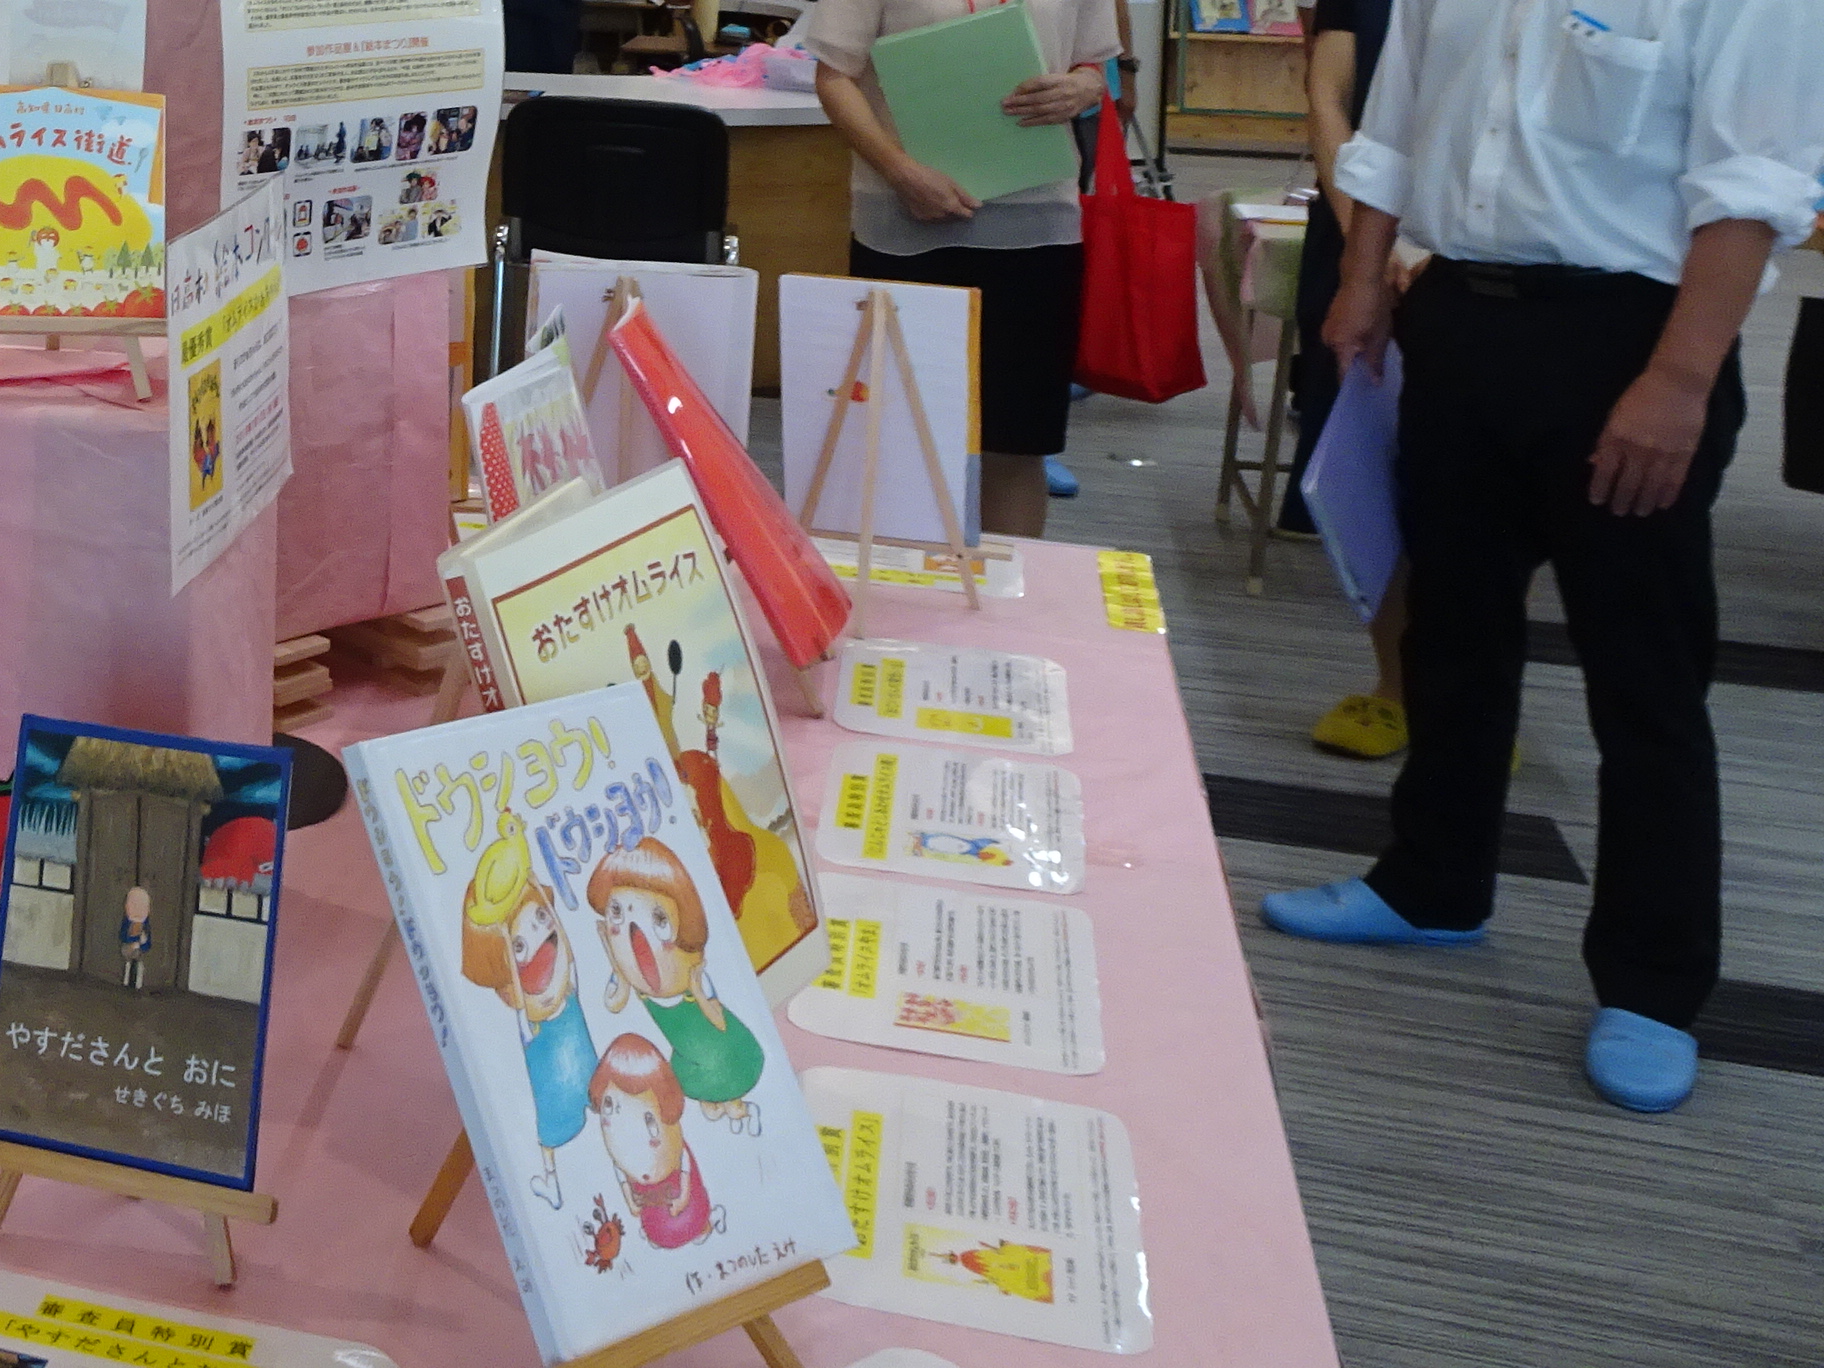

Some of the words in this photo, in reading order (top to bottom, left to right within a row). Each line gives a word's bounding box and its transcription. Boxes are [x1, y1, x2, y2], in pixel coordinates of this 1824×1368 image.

[532, 551, 705, 664] おたすけオムライス
[6, 1022, 165, 1076] やすださんと
[182, 1055, 236, 1089] おに
[114, 1086, 185, 1115] せきぐち
[194, 1099, 233, 1123] みほ
[5, 1319, 216, 1368] 「やすださんと
[42, 1298, 253, 1360] 審査員特別賞
